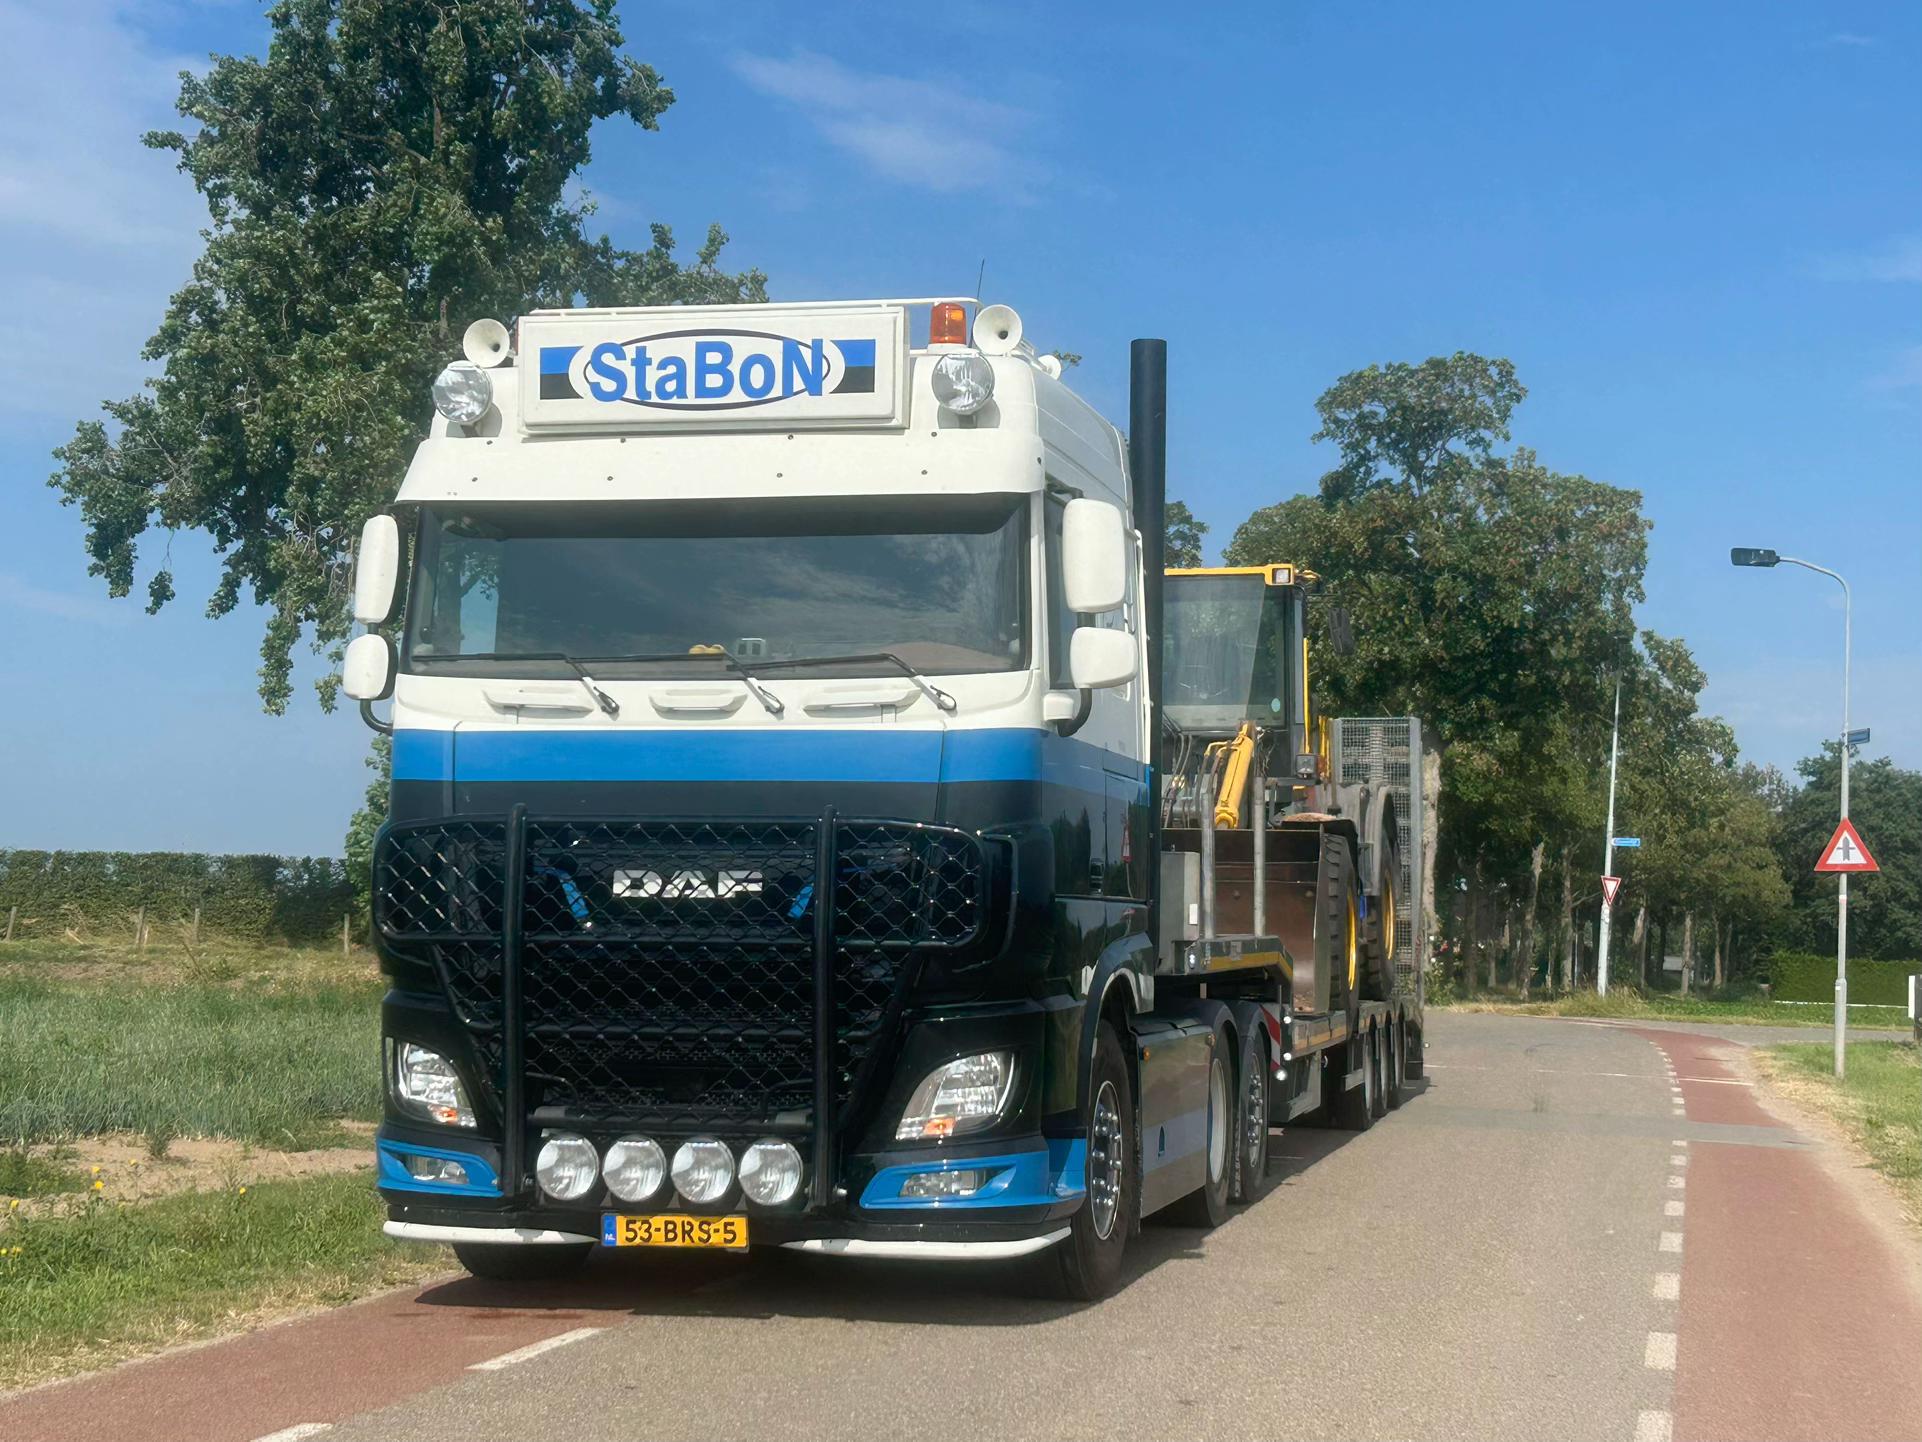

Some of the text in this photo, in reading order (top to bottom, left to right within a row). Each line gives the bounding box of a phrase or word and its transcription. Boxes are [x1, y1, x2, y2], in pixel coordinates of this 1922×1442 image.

[589, 338, 824, 402] StaBoN
[612, 870, 763, 898] DAF
[625, 1219, 737, 1244] 53-BRS-5
